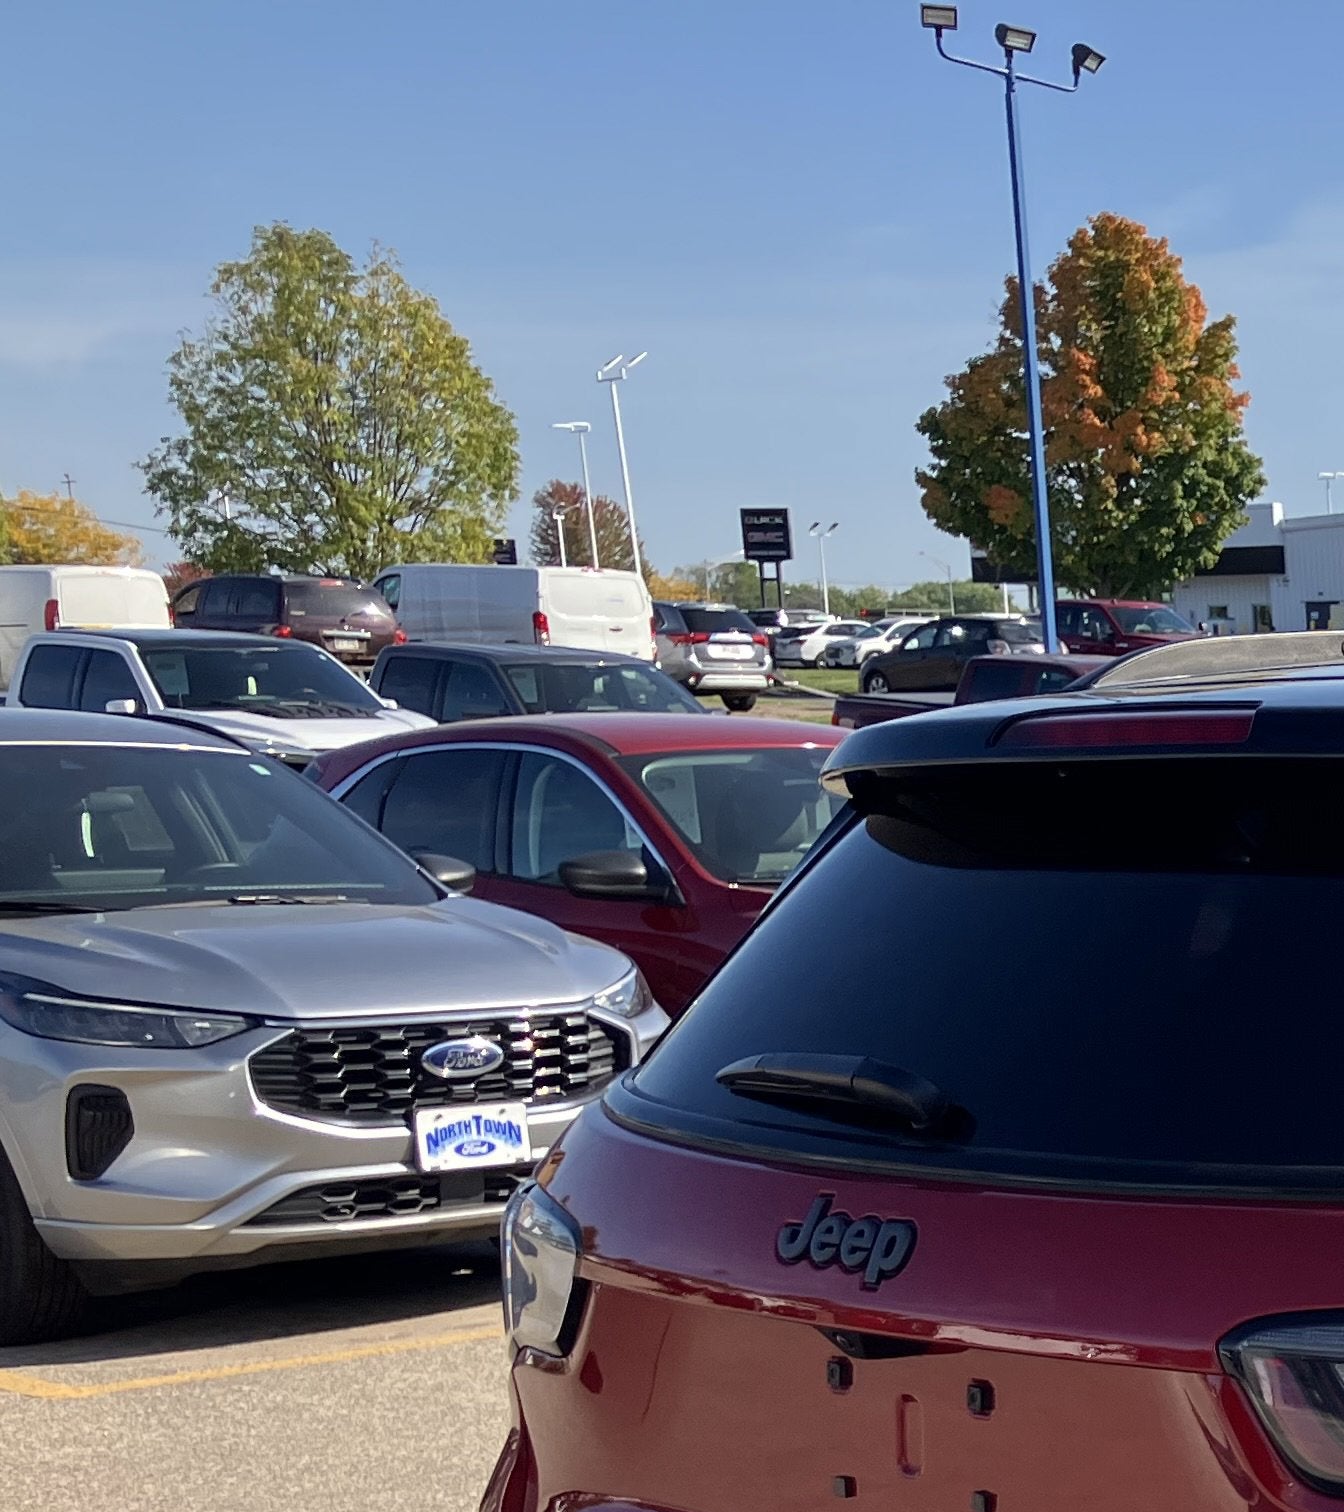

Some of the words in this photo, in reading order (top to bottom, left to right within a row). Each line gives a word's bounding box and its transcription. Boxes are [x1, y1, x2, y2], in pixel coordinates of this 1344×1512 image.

[747, 531, 784, 543] GMC
[443, 1048, 489, 1069] Ford
[459, 1141, 491, 1156] Ford
[776, 1191, 918, 1289] Jeep
